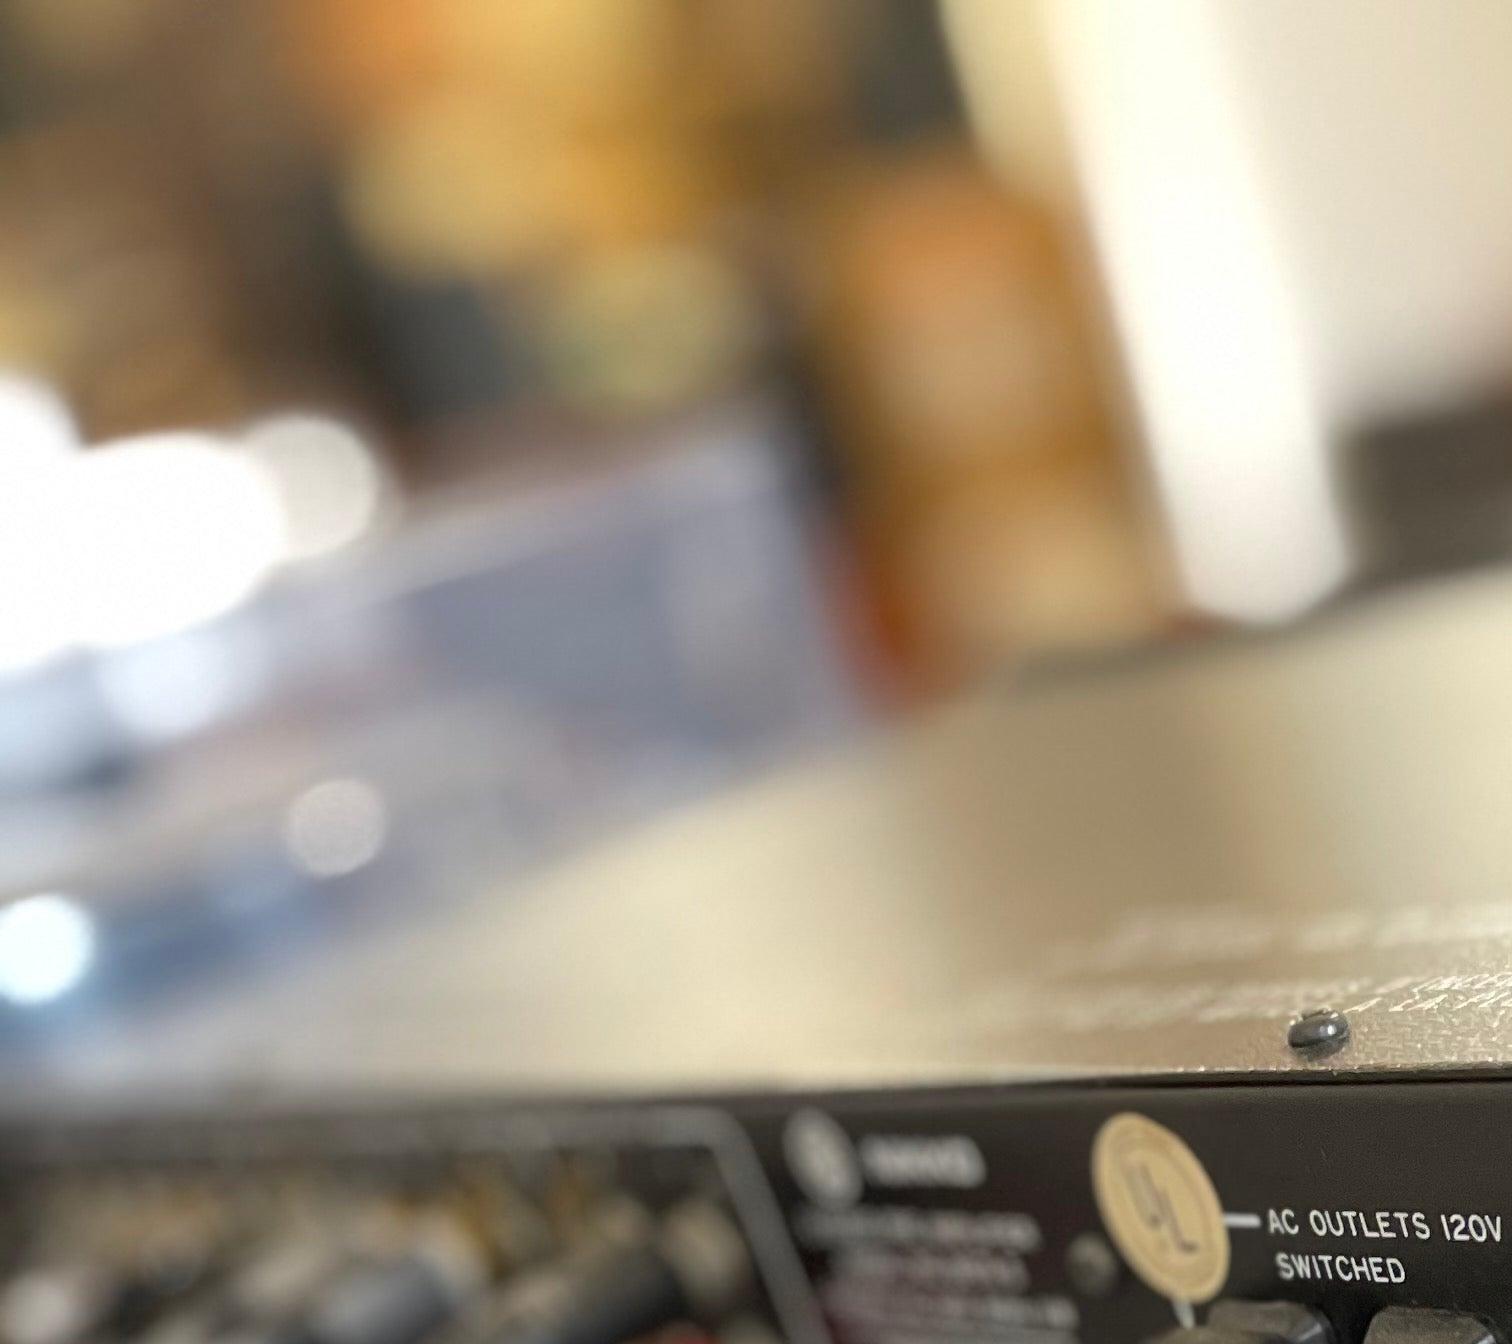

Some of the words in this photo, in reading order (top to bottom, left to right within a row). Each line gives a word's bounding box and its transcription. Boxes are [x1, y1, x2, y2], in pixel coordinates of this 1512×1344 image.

[1268, 1208, 1300, 1235] AC
[1309, 1209, 1431, 1240] OUTLETS
[1440, 1213, 1502, 1243] 120V
[1275, 1252, 1406, 1284] SWITCHED
